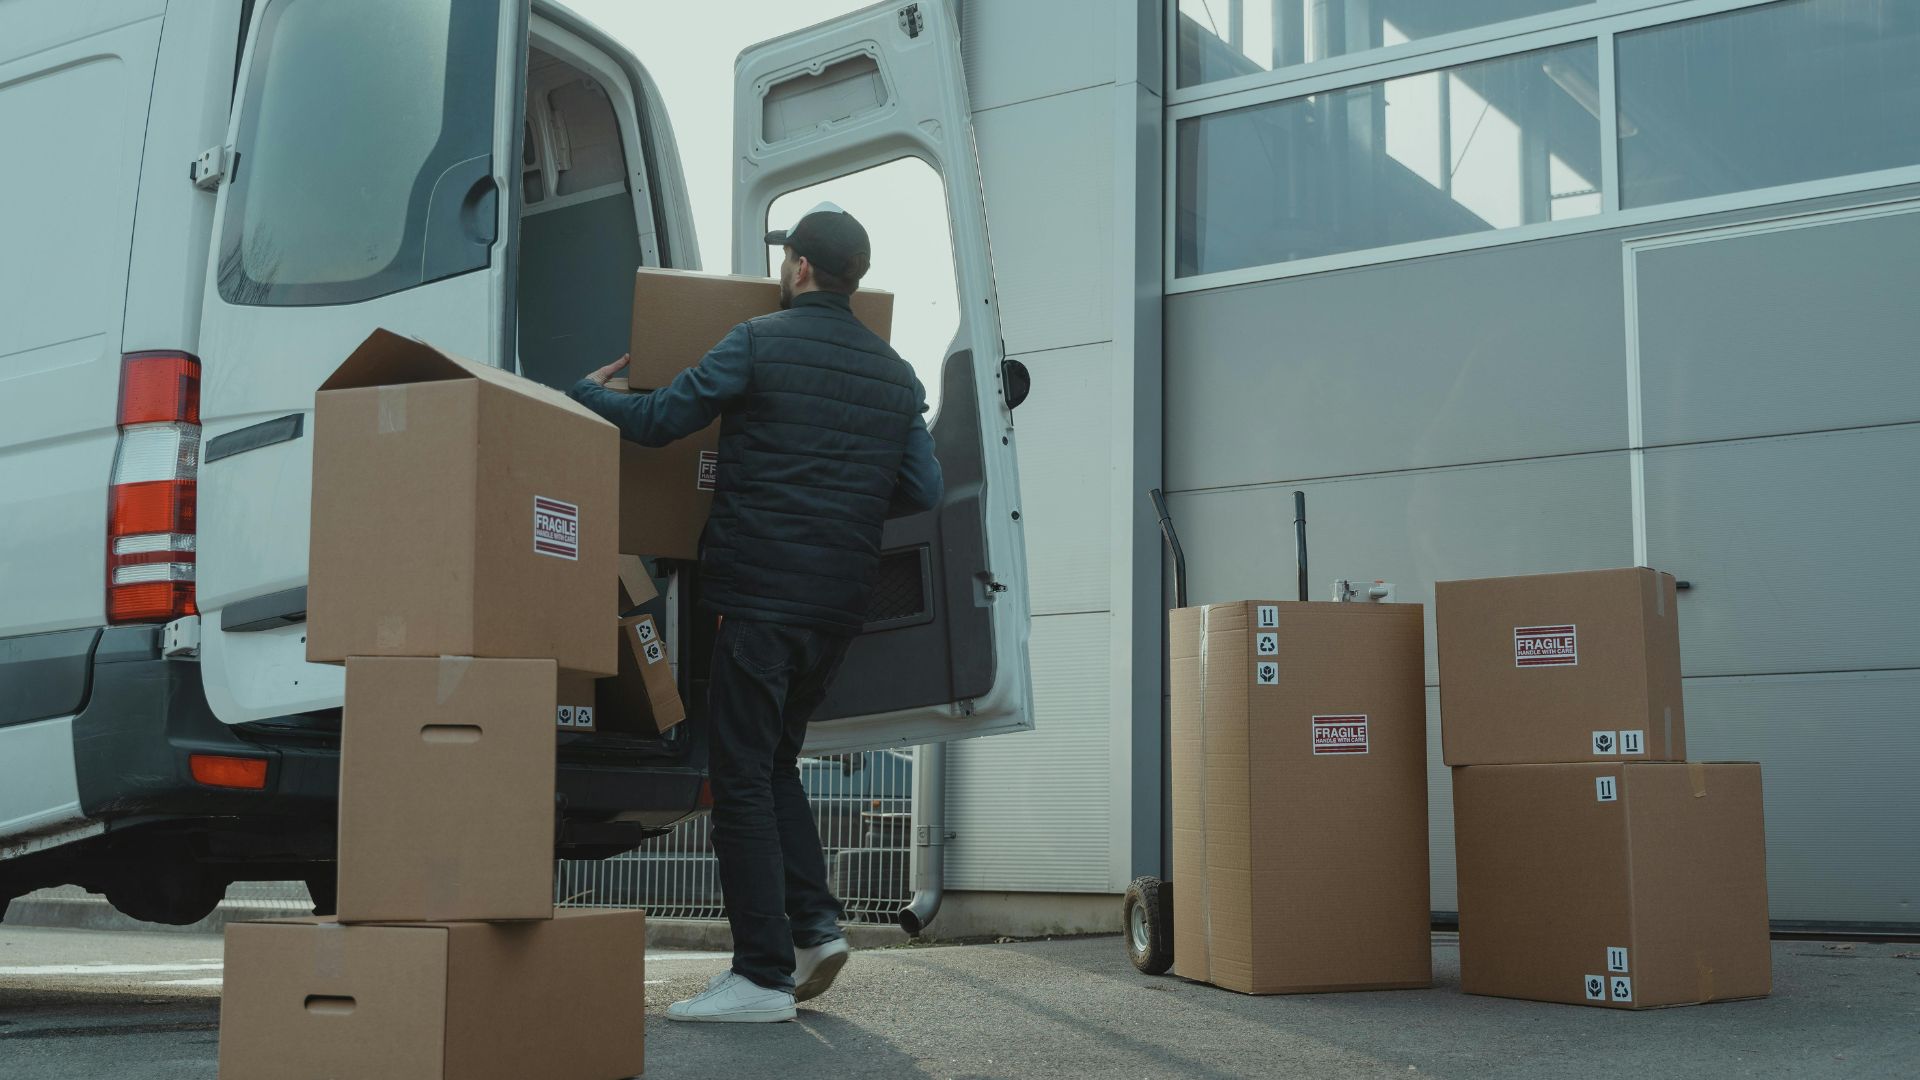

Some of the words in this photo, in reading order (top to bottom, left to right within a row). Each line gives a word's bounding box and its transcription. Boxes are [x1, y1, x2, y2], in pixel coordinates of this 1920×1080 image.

[536, 513, 576, 537] FRAGILE
[1517, 637, 1573, 651] FRAGILE
[1315, 727, 1365, 738] FRAGILE
